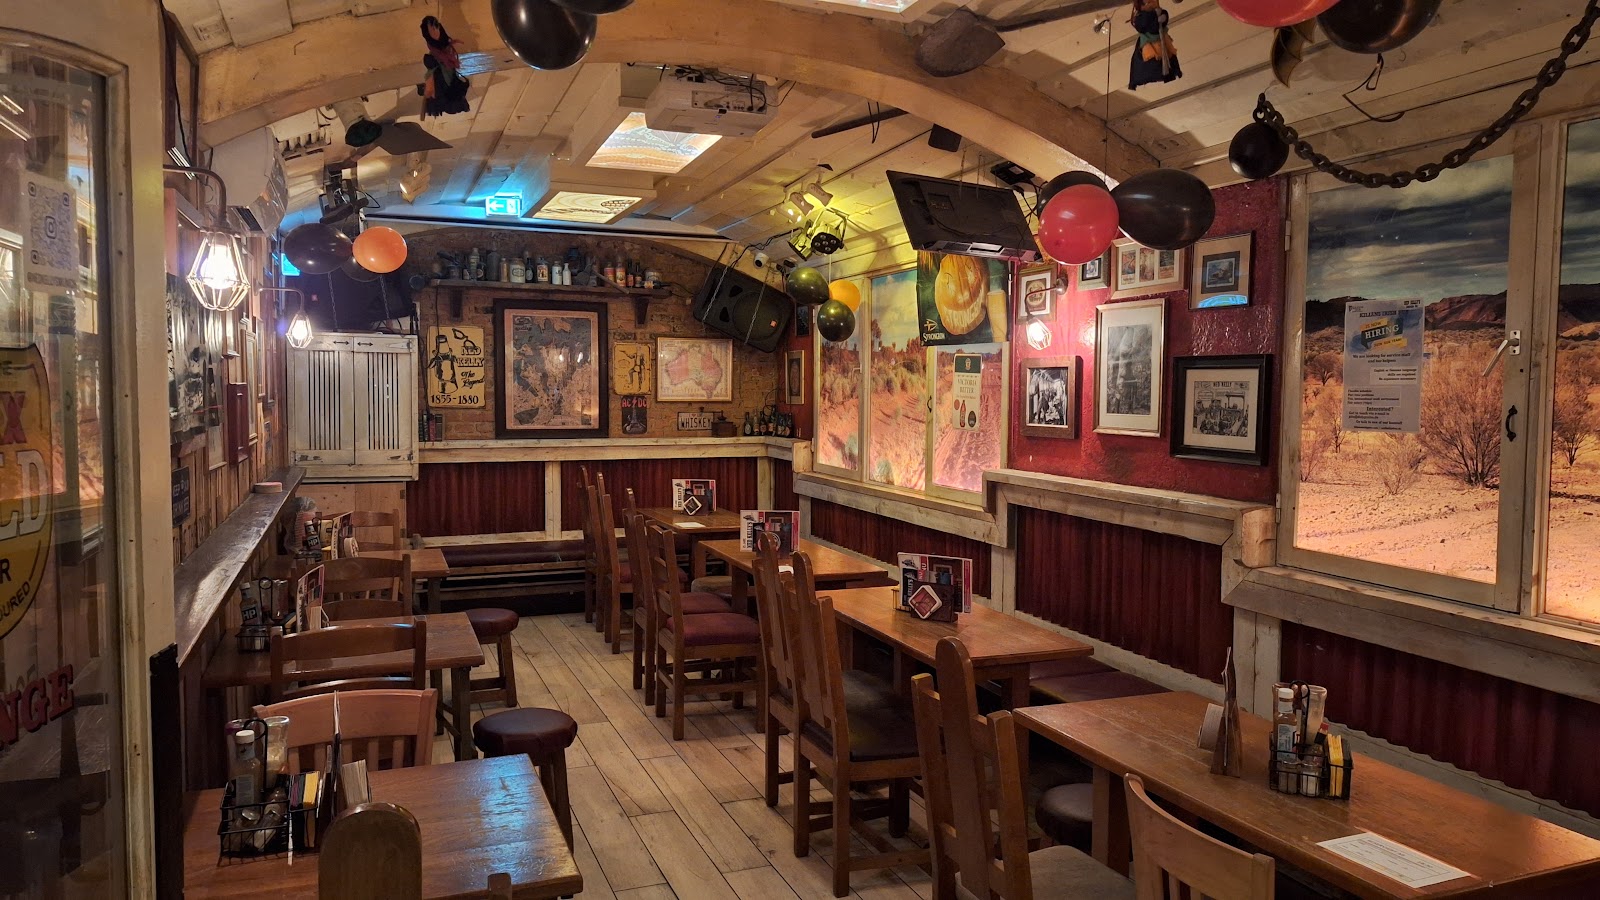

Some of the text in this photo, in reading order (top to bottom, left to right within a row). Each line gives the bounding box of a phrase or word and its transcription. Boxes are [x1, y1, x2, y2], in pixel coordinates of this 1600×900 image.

[1365, 324, 1400, 339] HIRING
[457, 357, 485, 368] KELLY
[461, 370, 476, 380] The
[680, 417, 712, 428] WHISKEY
[308, 538, 318, 546] HP
[243, 609, 256, 620] HP
